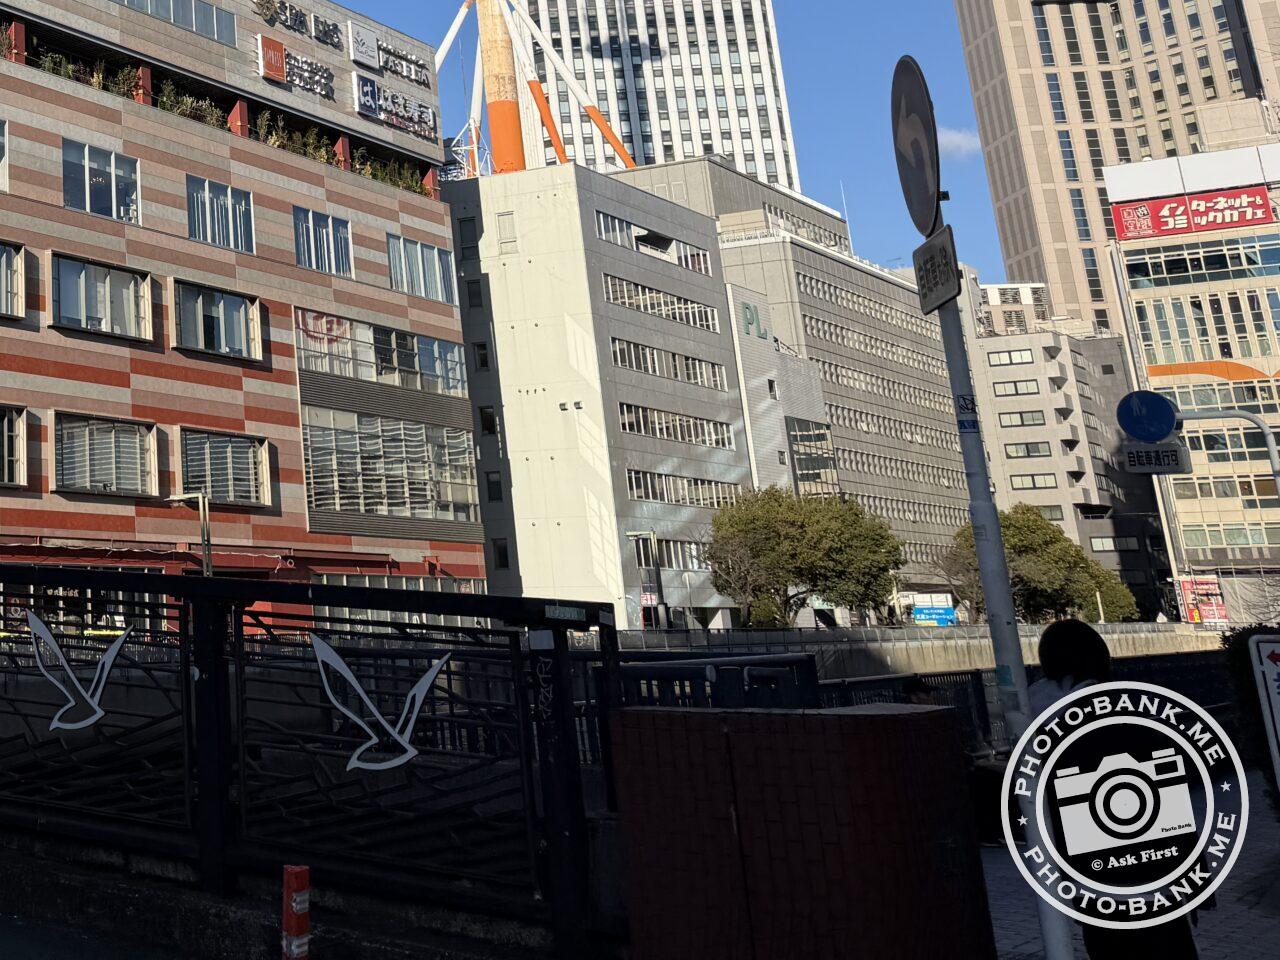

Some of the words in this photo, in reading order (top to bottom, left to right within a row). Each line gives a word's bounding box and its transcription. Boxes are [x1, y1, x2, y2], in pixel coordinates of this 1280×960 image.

[1160, 208, 1266, 230] コミックカフェ
[741, 301, 767, 340] PL
